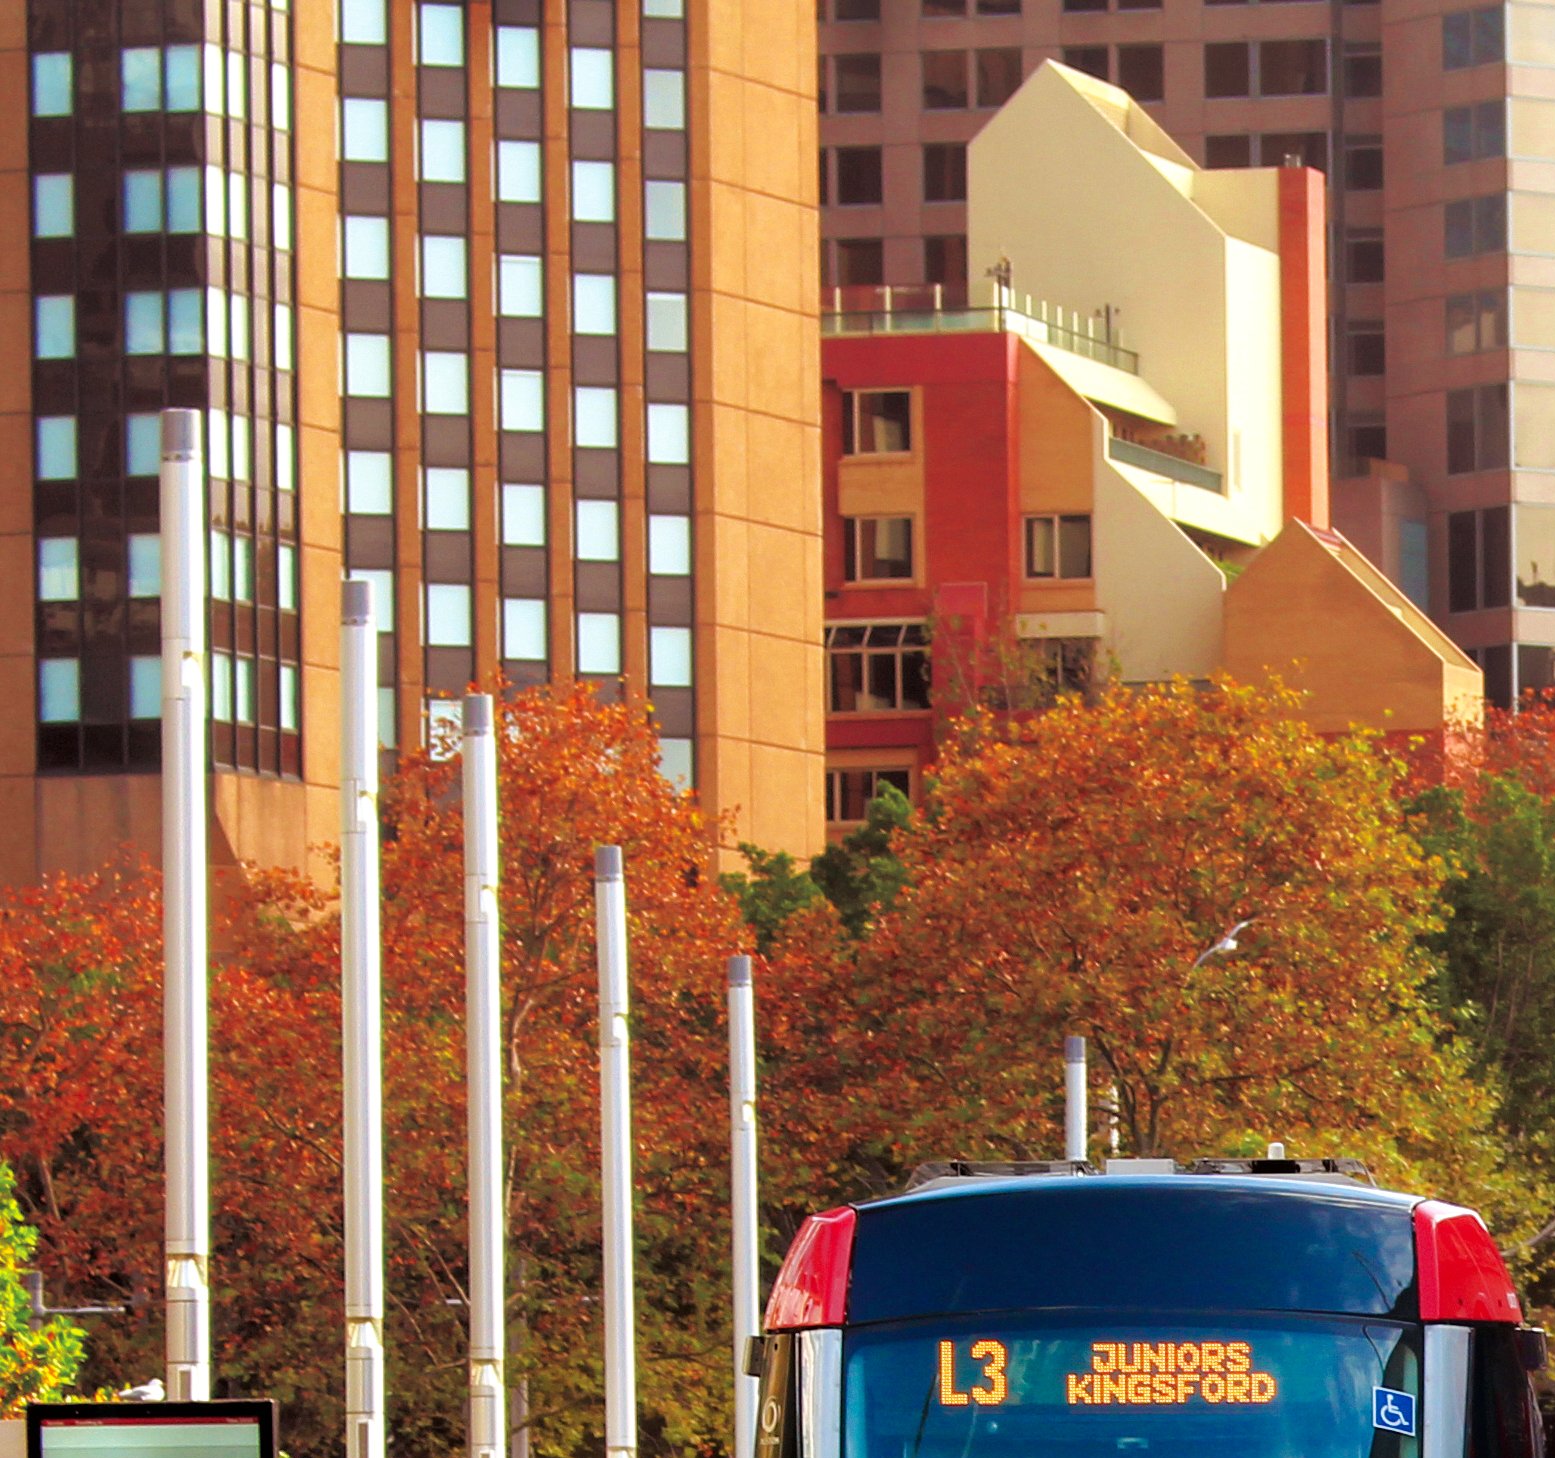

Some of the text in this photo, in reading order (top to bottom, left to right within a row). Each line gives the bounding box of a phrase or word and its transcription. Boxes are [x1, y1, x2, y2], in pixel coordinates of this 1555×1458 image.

[938, 1340, 1008, 1405] L3
[1092, 1342, 1251, 1373] JUNIORS
[1067, 1373, 1276, 1405] KINGSFORD
